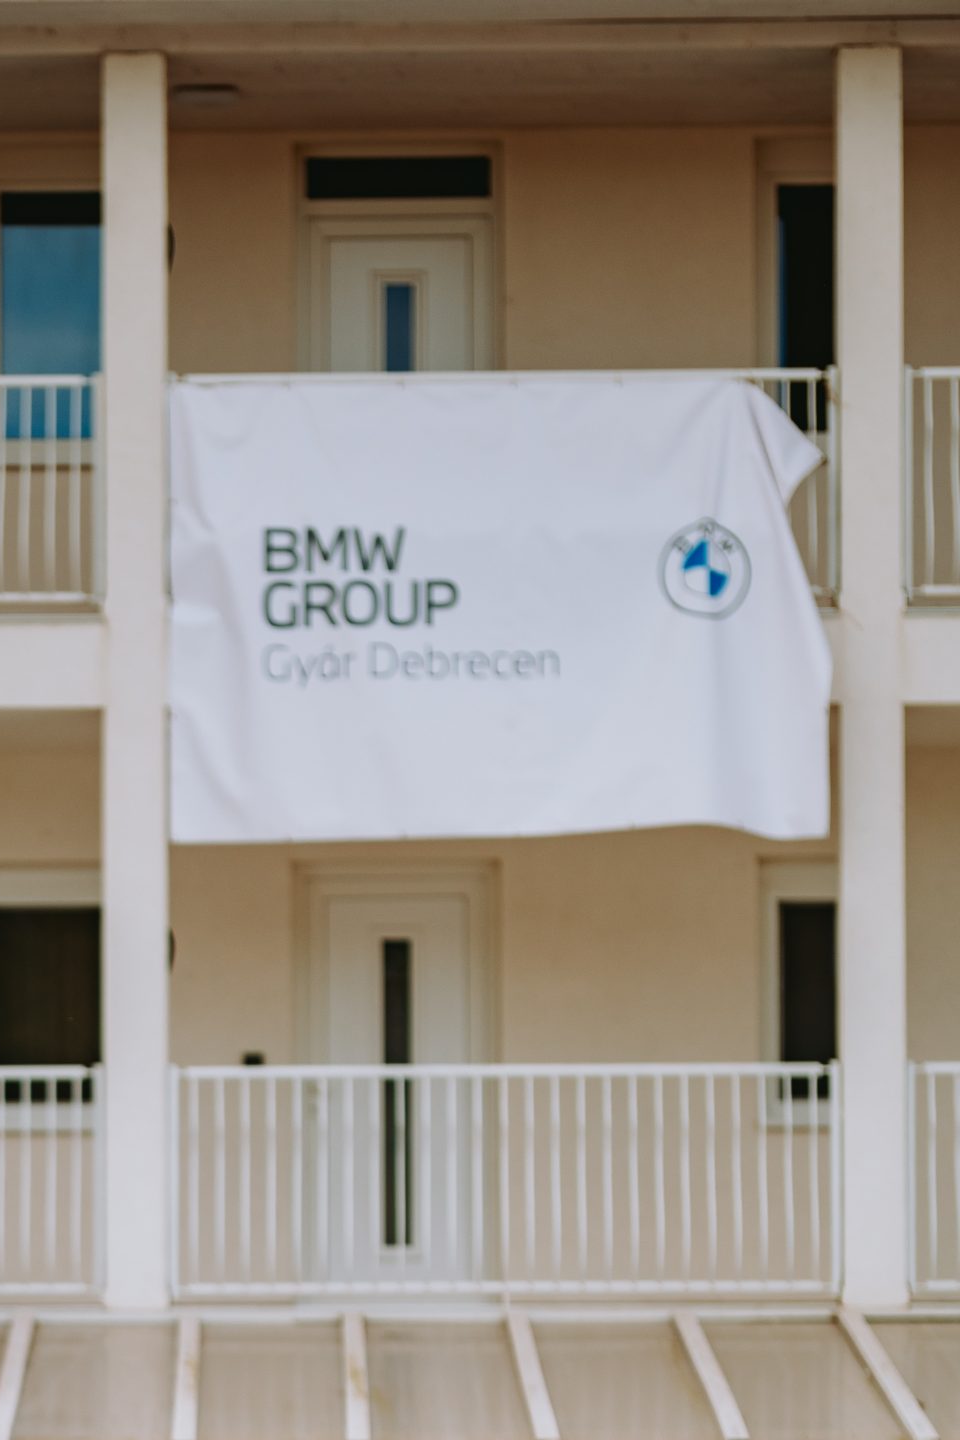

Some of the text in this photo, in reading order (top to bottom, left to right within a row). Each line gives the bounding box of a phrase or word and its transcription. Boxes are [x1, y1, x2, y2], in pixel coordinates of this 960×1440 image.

[262, 526, 405, 574] BMW
[262, 578, 460, 630] GROUP
[369, 642, 561, 682] Debrecen
